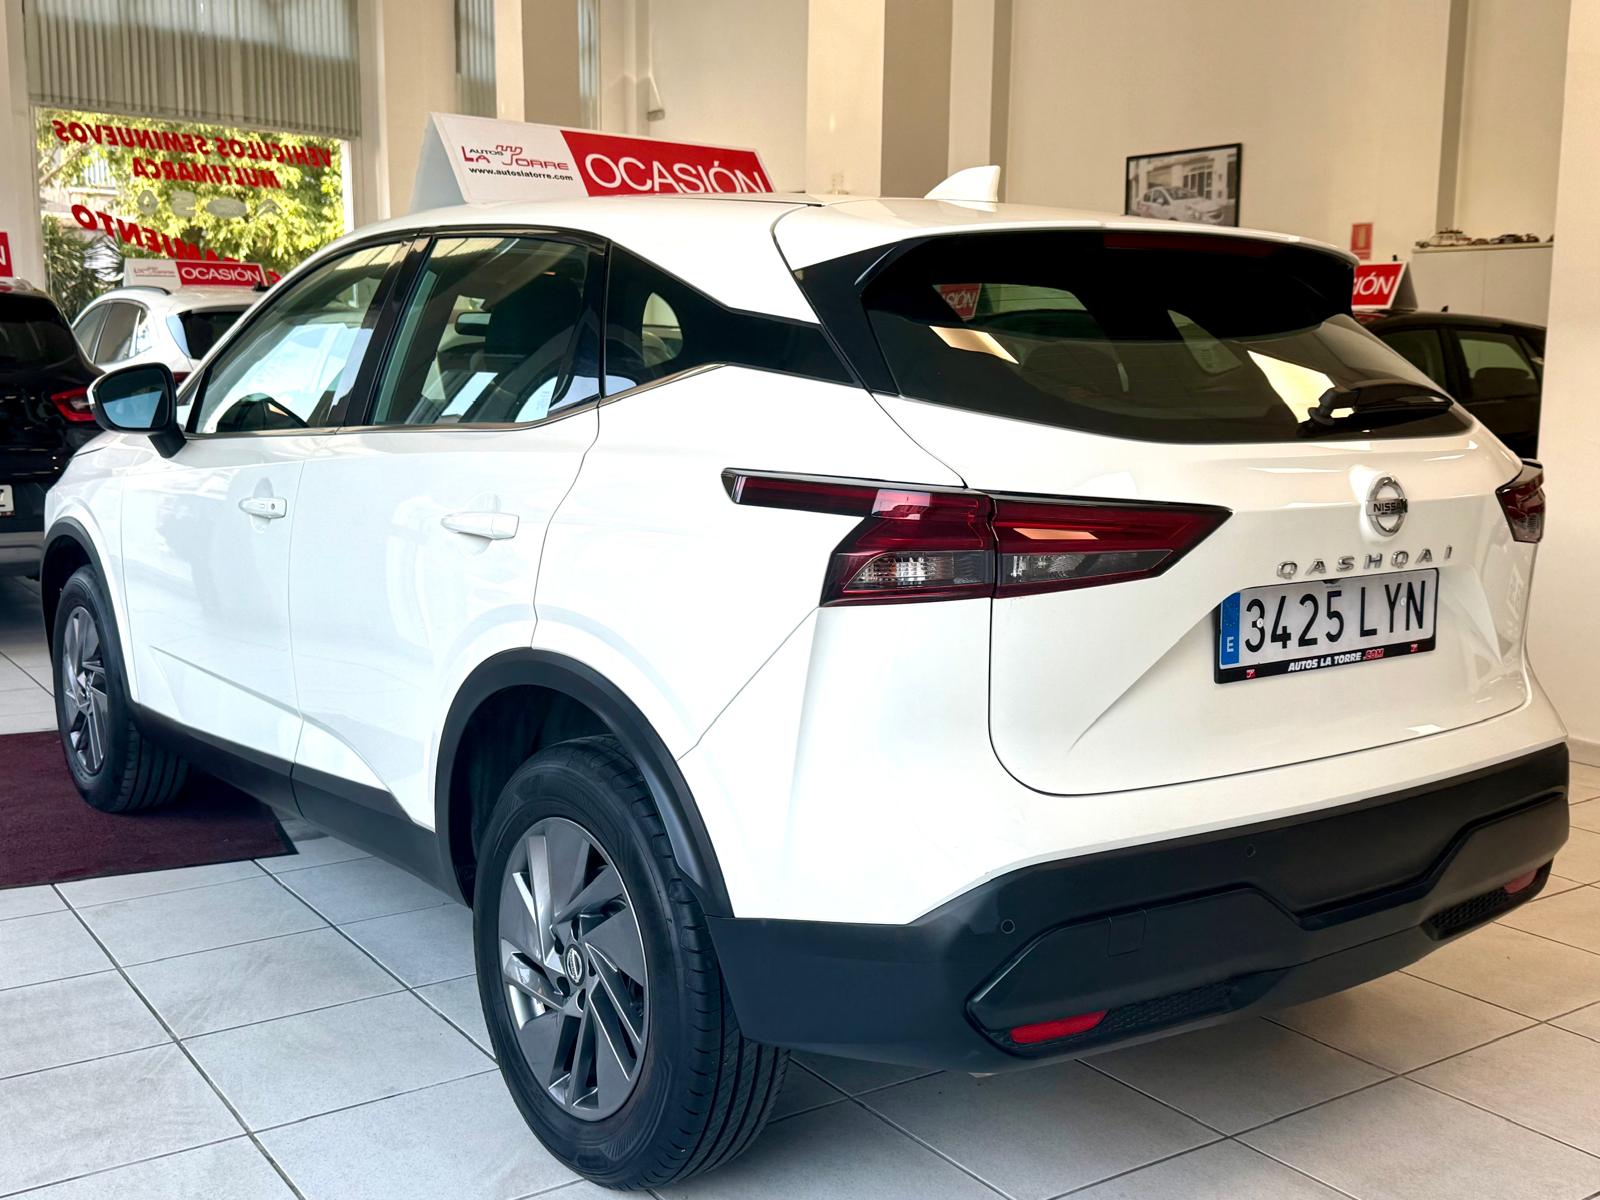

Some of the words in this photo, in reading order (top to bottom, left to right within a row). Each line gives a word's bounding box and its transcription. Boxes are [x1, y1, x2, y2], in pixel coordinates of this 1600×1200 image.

[461, 146, 490, 163] LA
[496, 145, 569, 170] TORRE
[469, 148, 504, 156] AUTOS
[469, 167, 573, 181] www.autoslatorre.com
[585, 153, 766, 193] OCASIÓN
[181, 267, 260, 282] OCASIÓN
[1353, 271, 1394, 296] IÓN
[1277, 545, 1453, 580] QASHQAI
[1245, 590, 1344, 653] 3425
[1360, 580, 1426, 637] LYN
[1226, 636, 1234, 653] E
[1288, 657, 1318, 672] AUTOS
[1319, 656, 1333, 667] LA
[1333, 652, 1362, 666] TORRE
